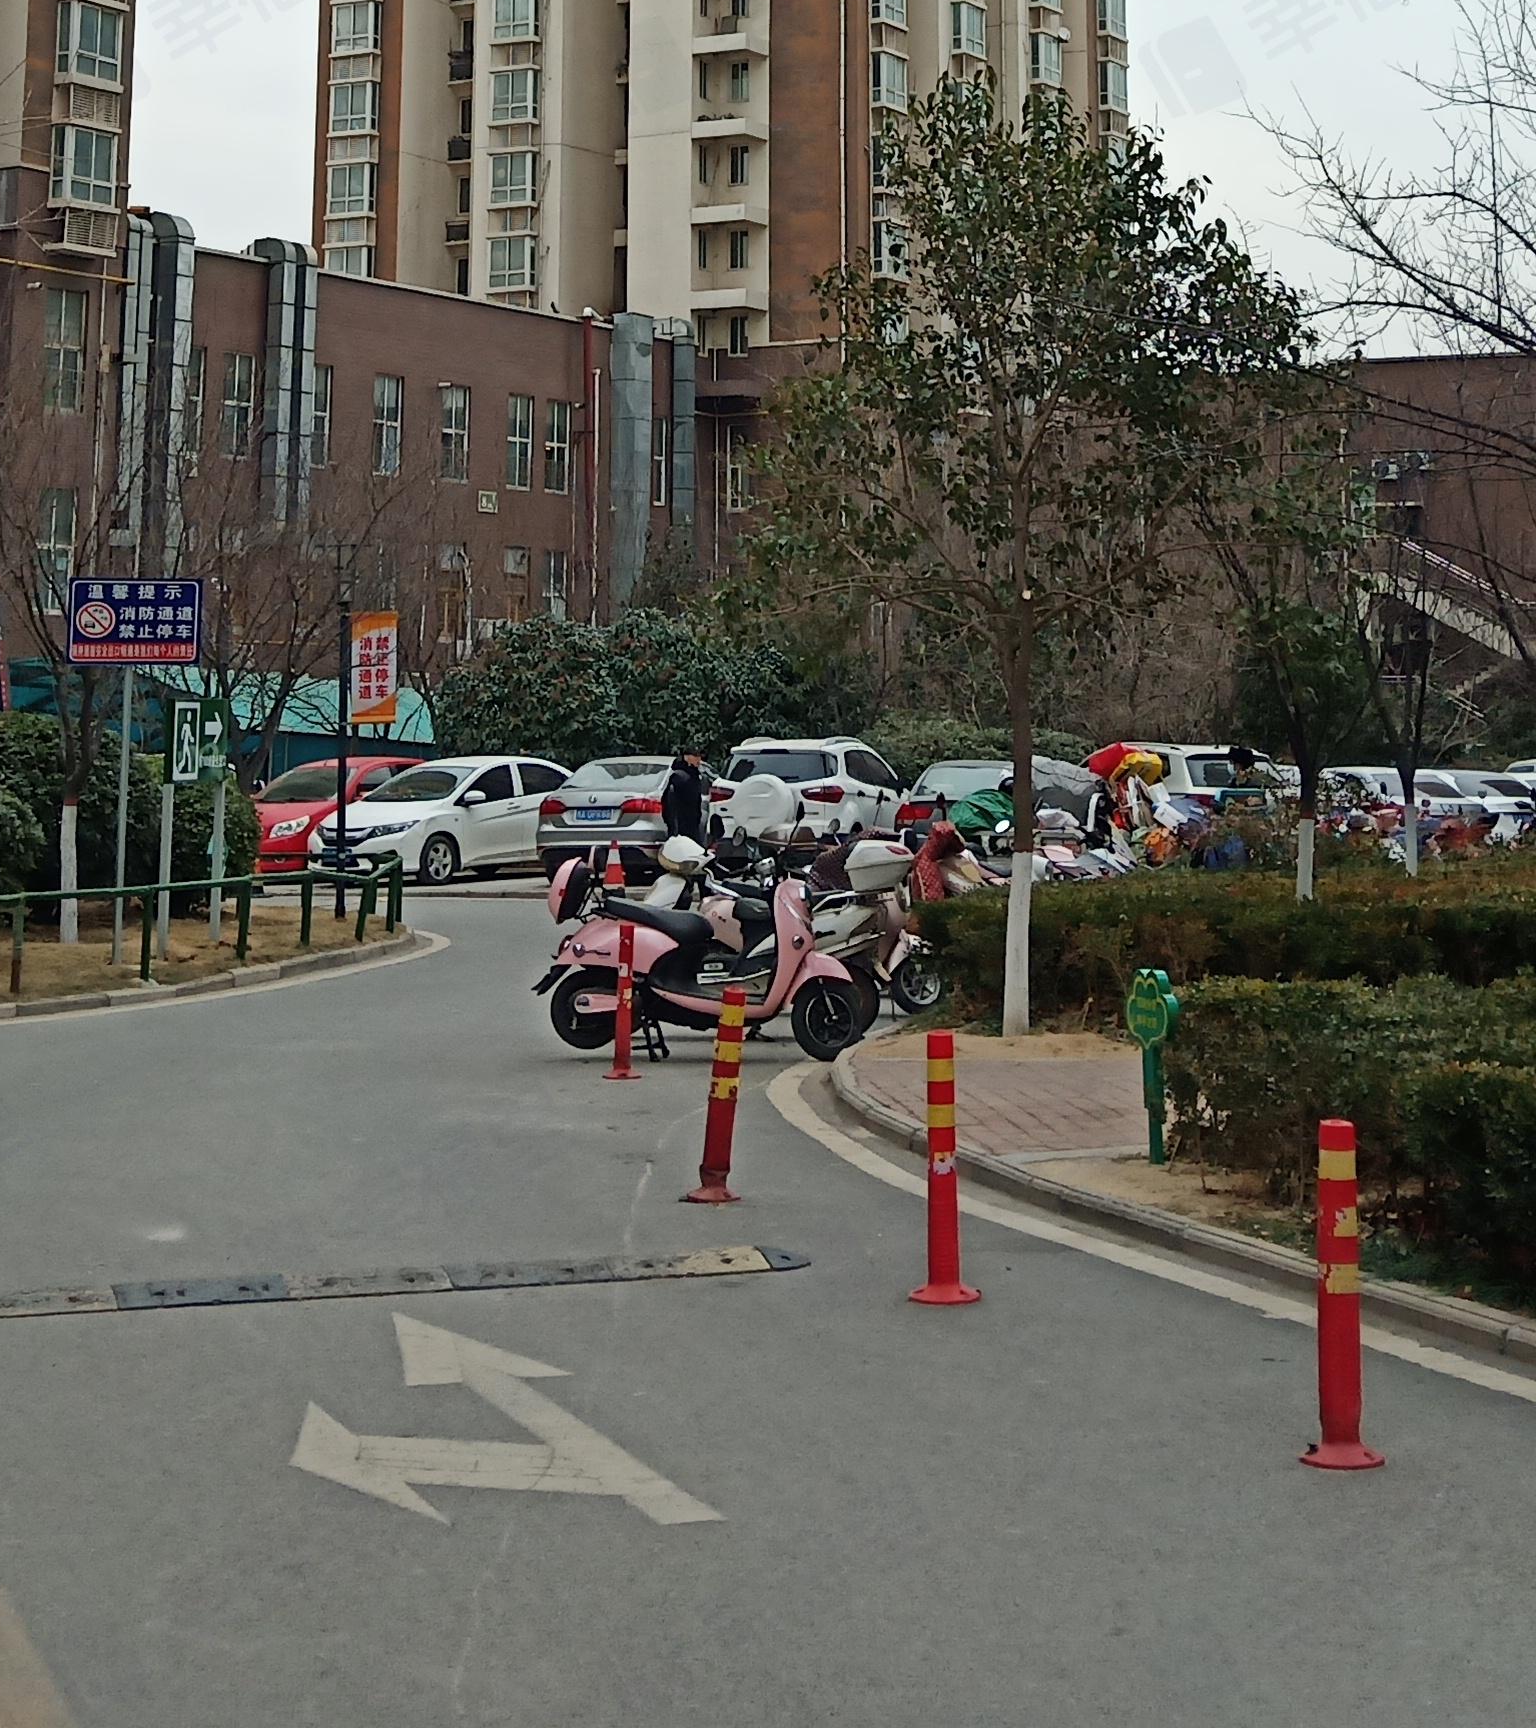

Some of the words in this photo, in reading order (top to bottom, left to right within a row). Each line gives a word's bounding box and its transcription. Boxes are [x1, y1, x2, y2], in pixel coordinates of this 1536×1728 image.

[88, 584, 182, 600] 温馨提示
[119, 605, 193, 621] 消防通道
[119, 624, 192, 639] 禁止停车
[359, 636, 372, 699] 消防通道
[375, 636, 389, 698] 禁止停车
